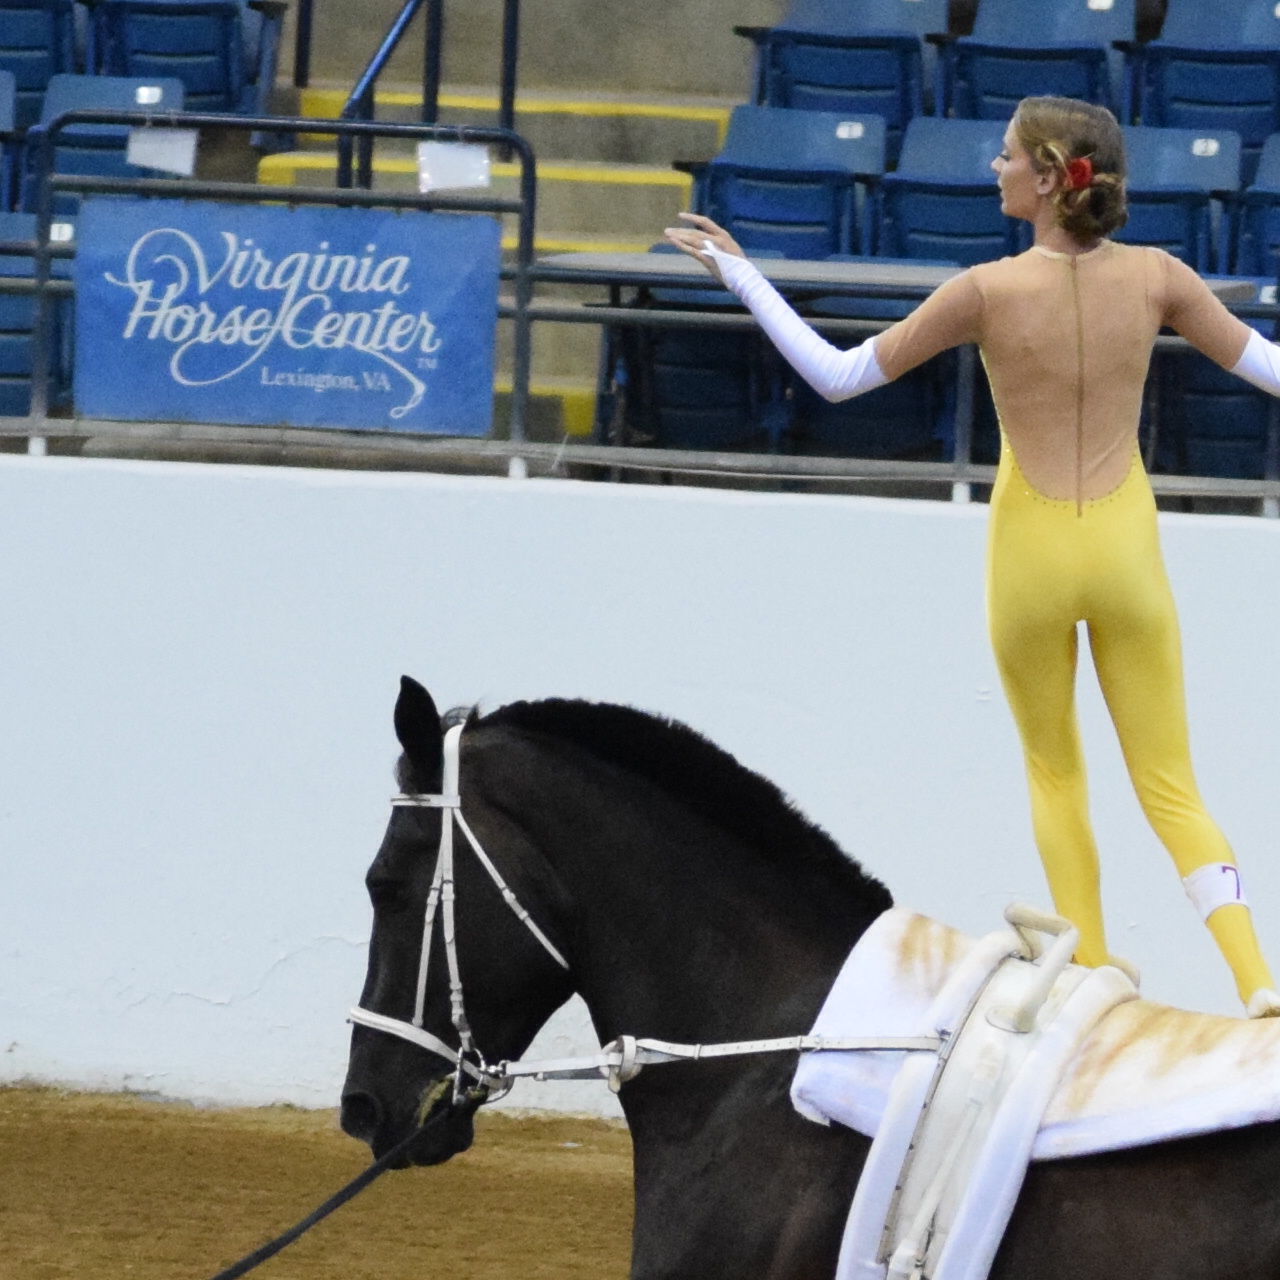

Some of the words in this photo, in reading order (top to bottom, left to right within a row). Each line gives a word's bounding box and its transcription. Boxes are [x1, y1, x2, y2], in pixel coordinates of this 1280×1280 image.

[107, 228, 412, 302] Virginia
[124, 280, 272, 346] Horse
[280, 294, 442, 354] Center
[362, 371, 392, 392] VA
